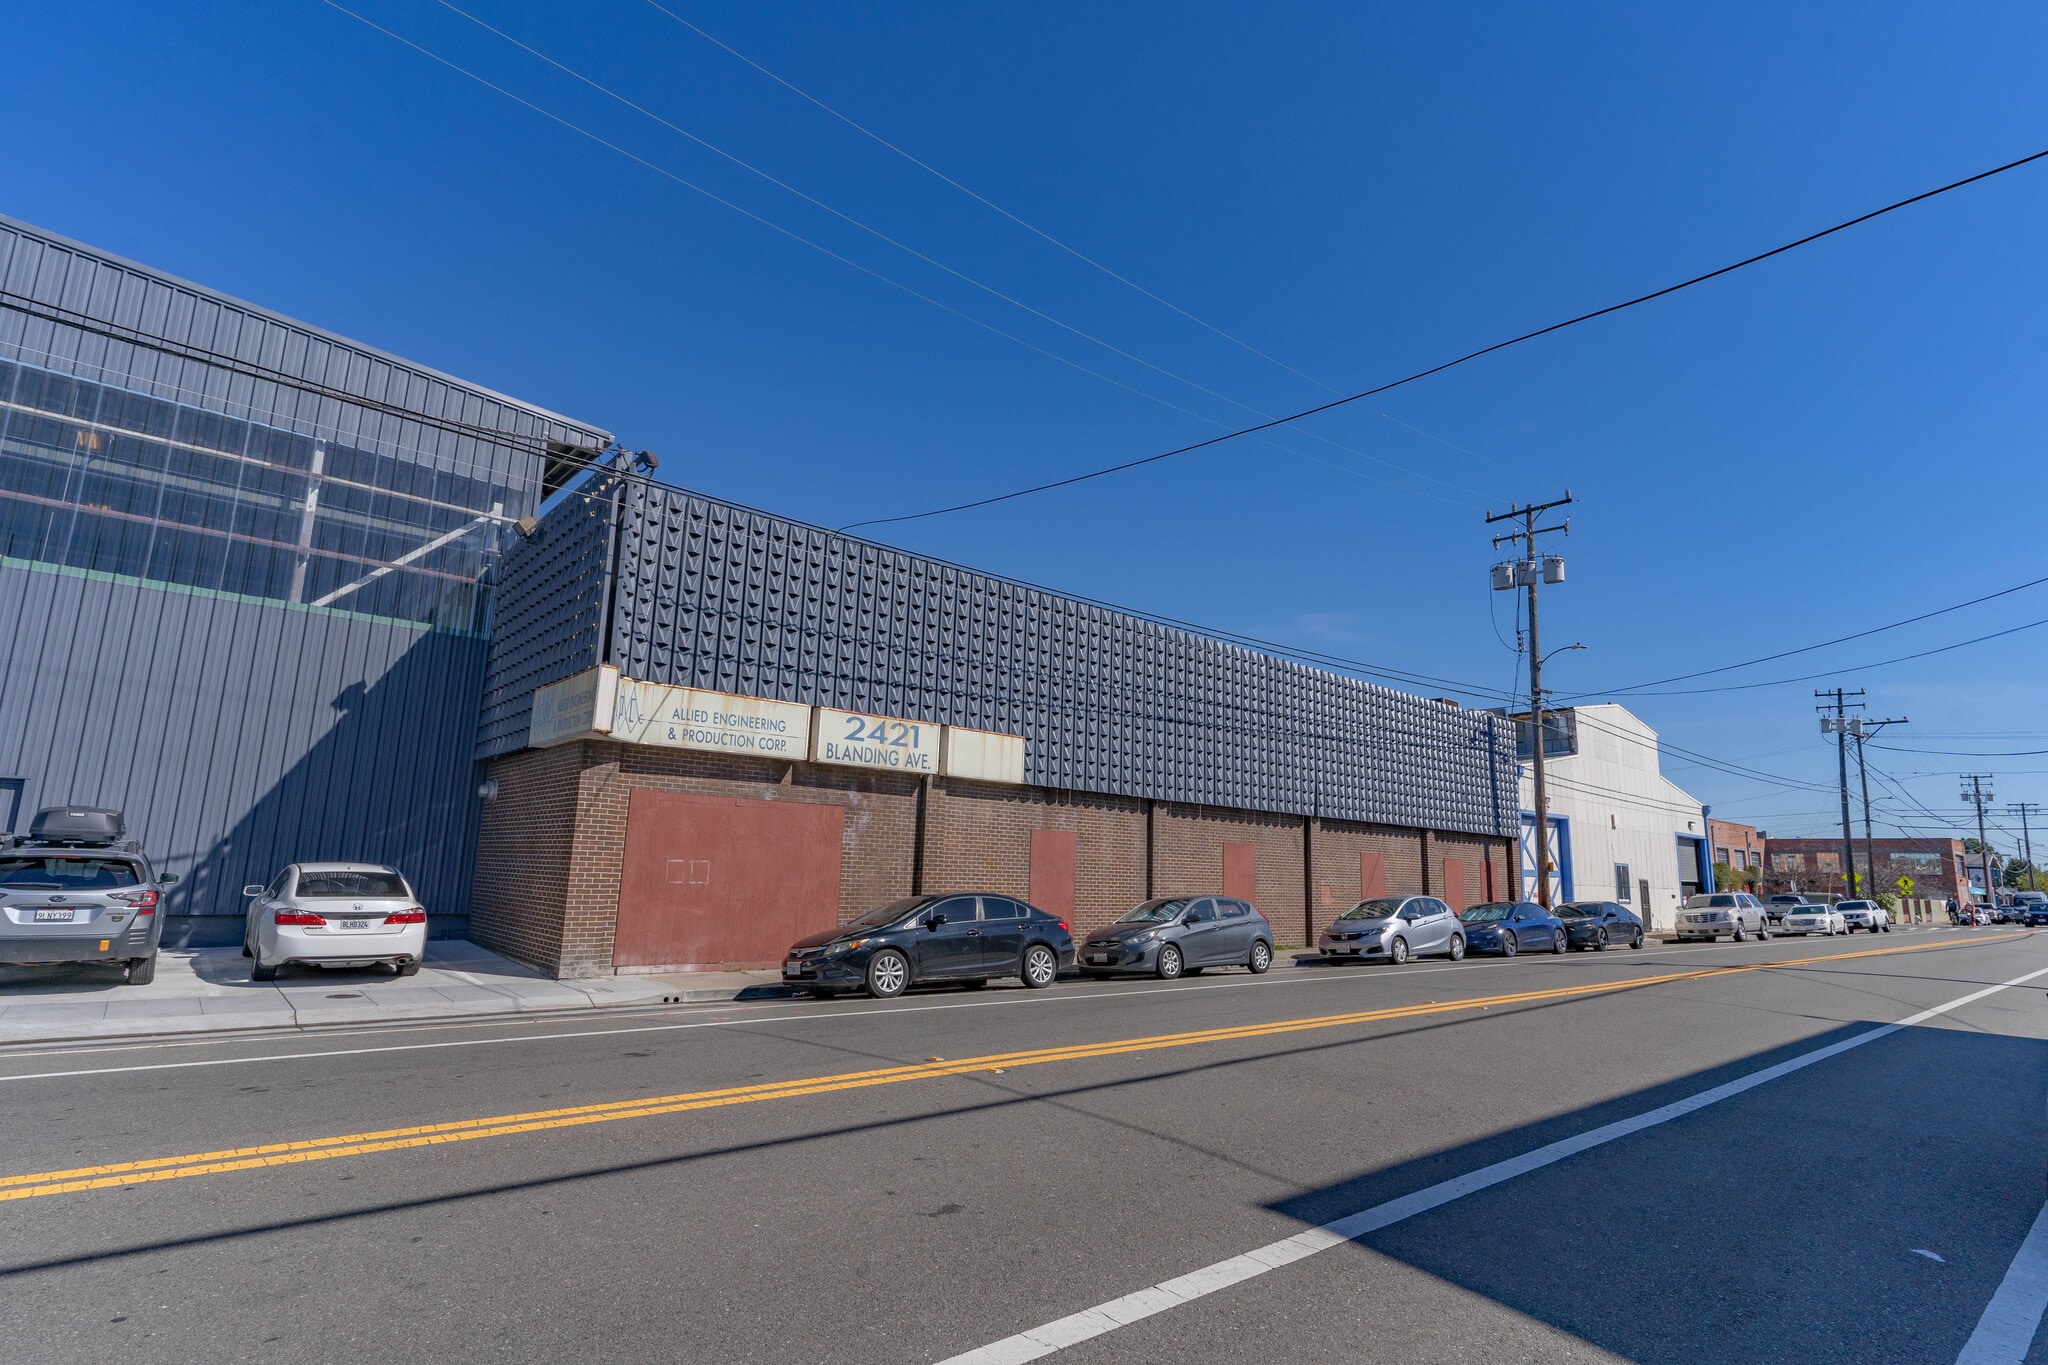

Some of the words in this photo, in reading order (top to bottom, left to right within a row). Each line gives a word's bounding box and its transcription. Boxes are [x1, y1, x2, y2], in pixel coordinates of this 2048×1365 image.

[672, 708, 709, 723] ALLIED
[713, 712, 786, 732] ENGINEERING
[843, 716, 920, 749] 2421
[668, 727, 676, 740] &
[682, 729, 755, 748] PRODUCTION
[758, 737, 787, 752] CORP.
[826, 742, 899, 766] BLANDING
[904, 752, 931, 770] AVE.
